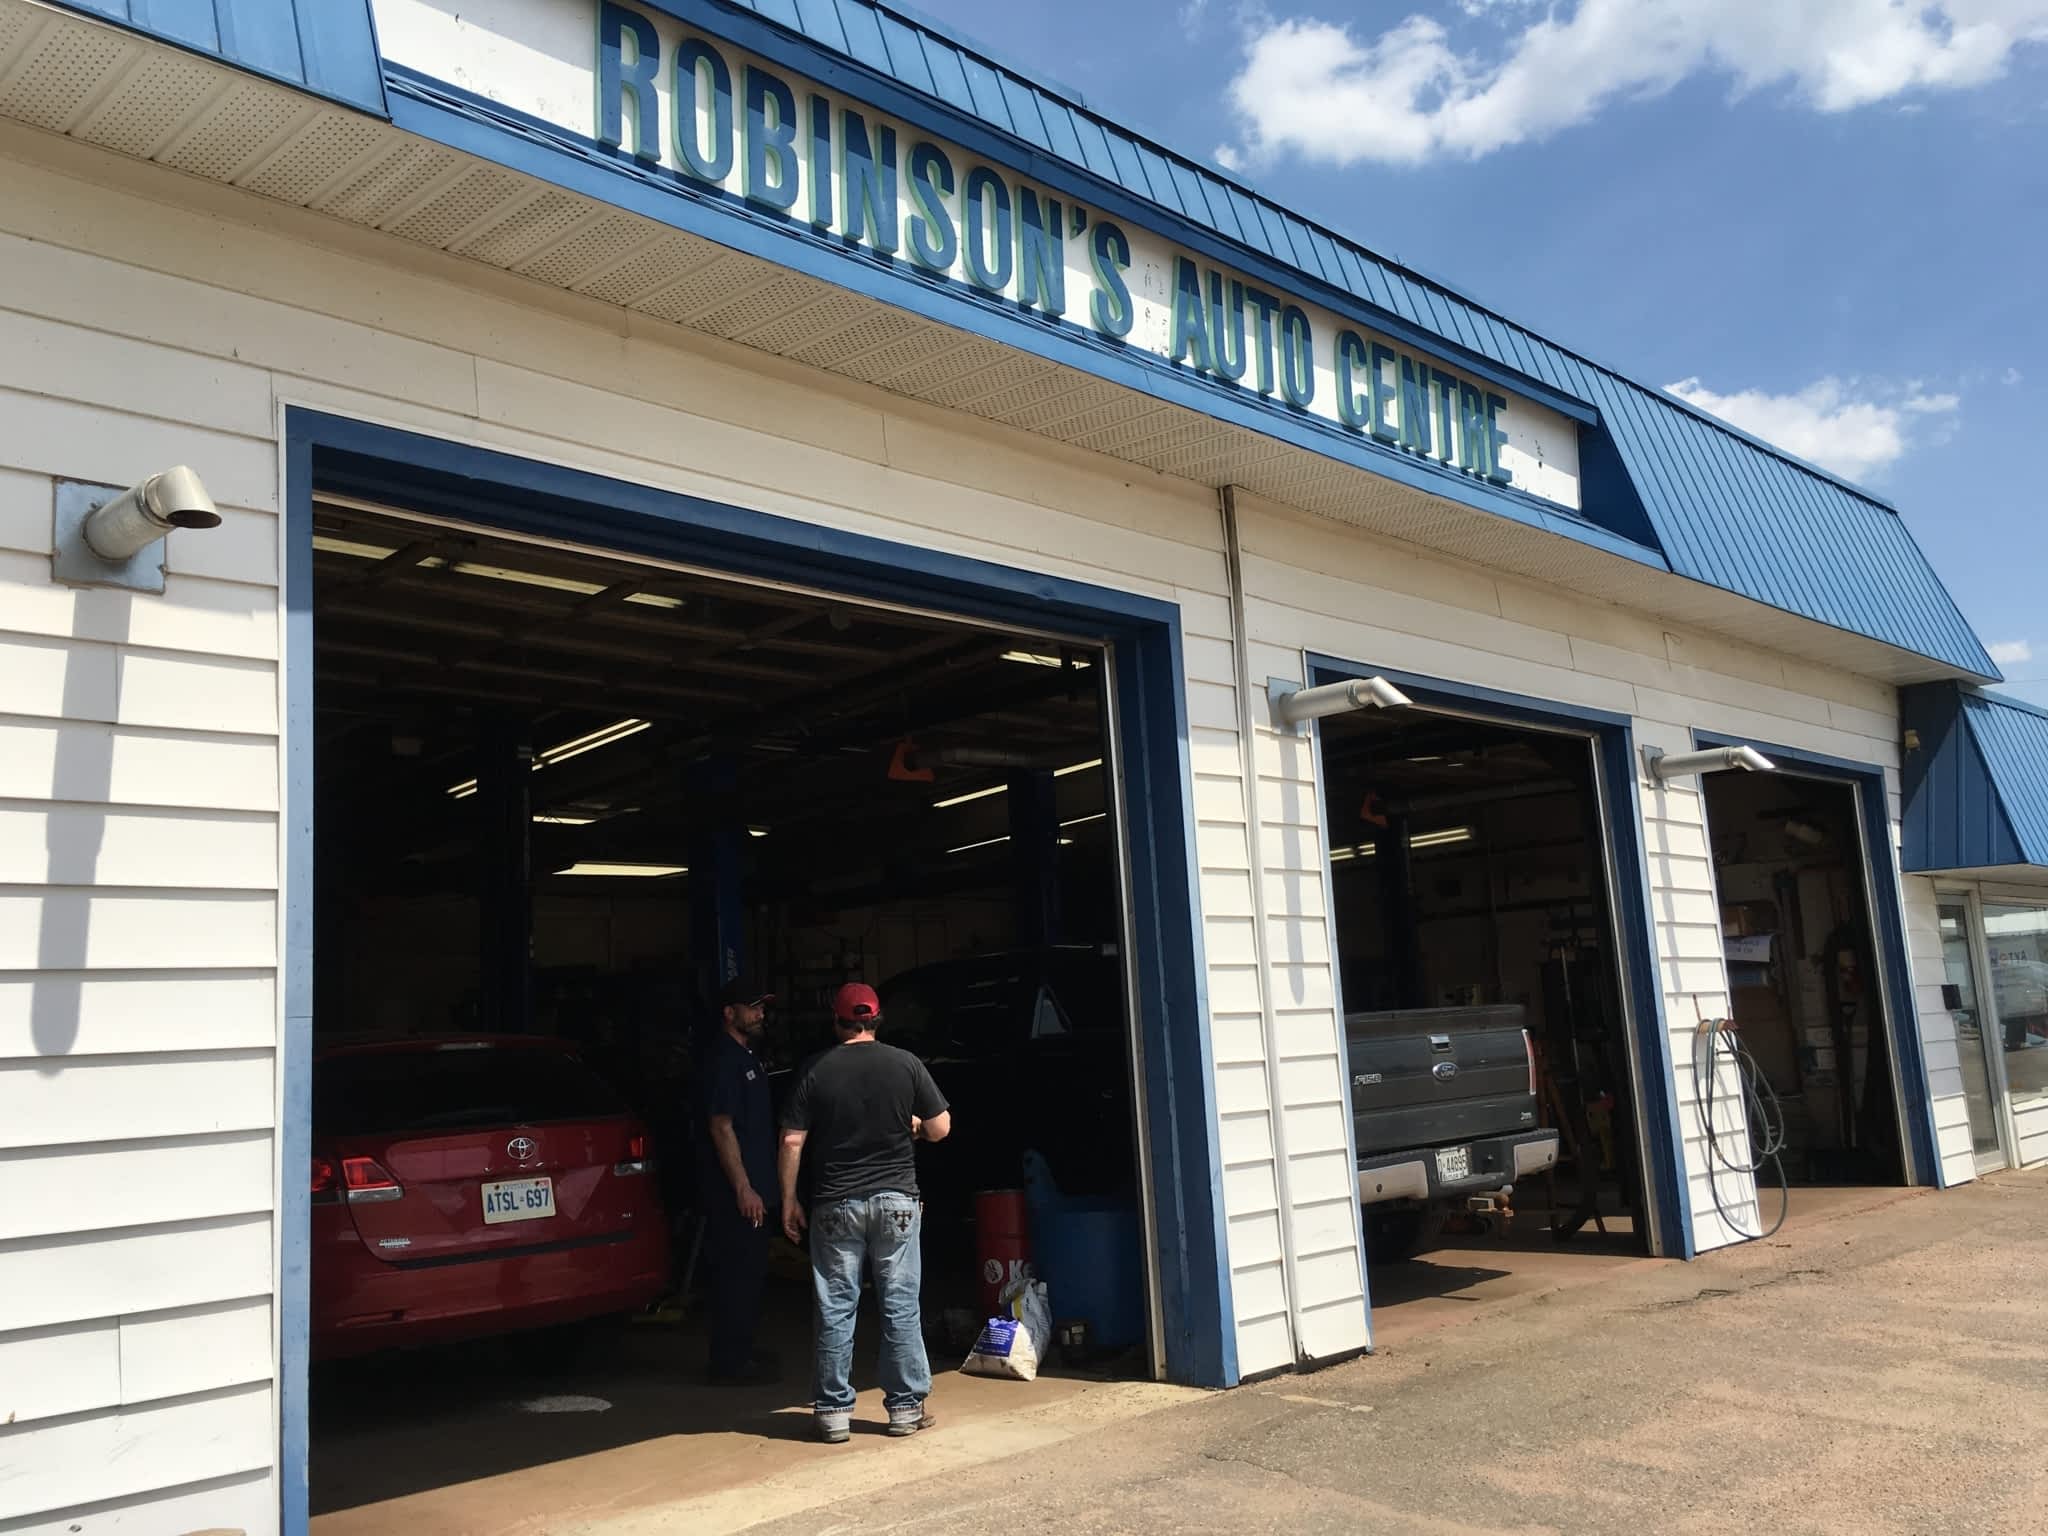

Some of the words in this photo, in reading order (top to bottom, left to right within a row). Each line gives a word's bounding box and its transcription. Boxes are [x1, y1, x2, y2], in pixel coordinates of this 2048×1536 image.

[594, 0, 1132, 337] ROBINSON'S
[1170, 255, 1314, 408] AUTO
[1335, 330, 1512, 483] CENTRE
